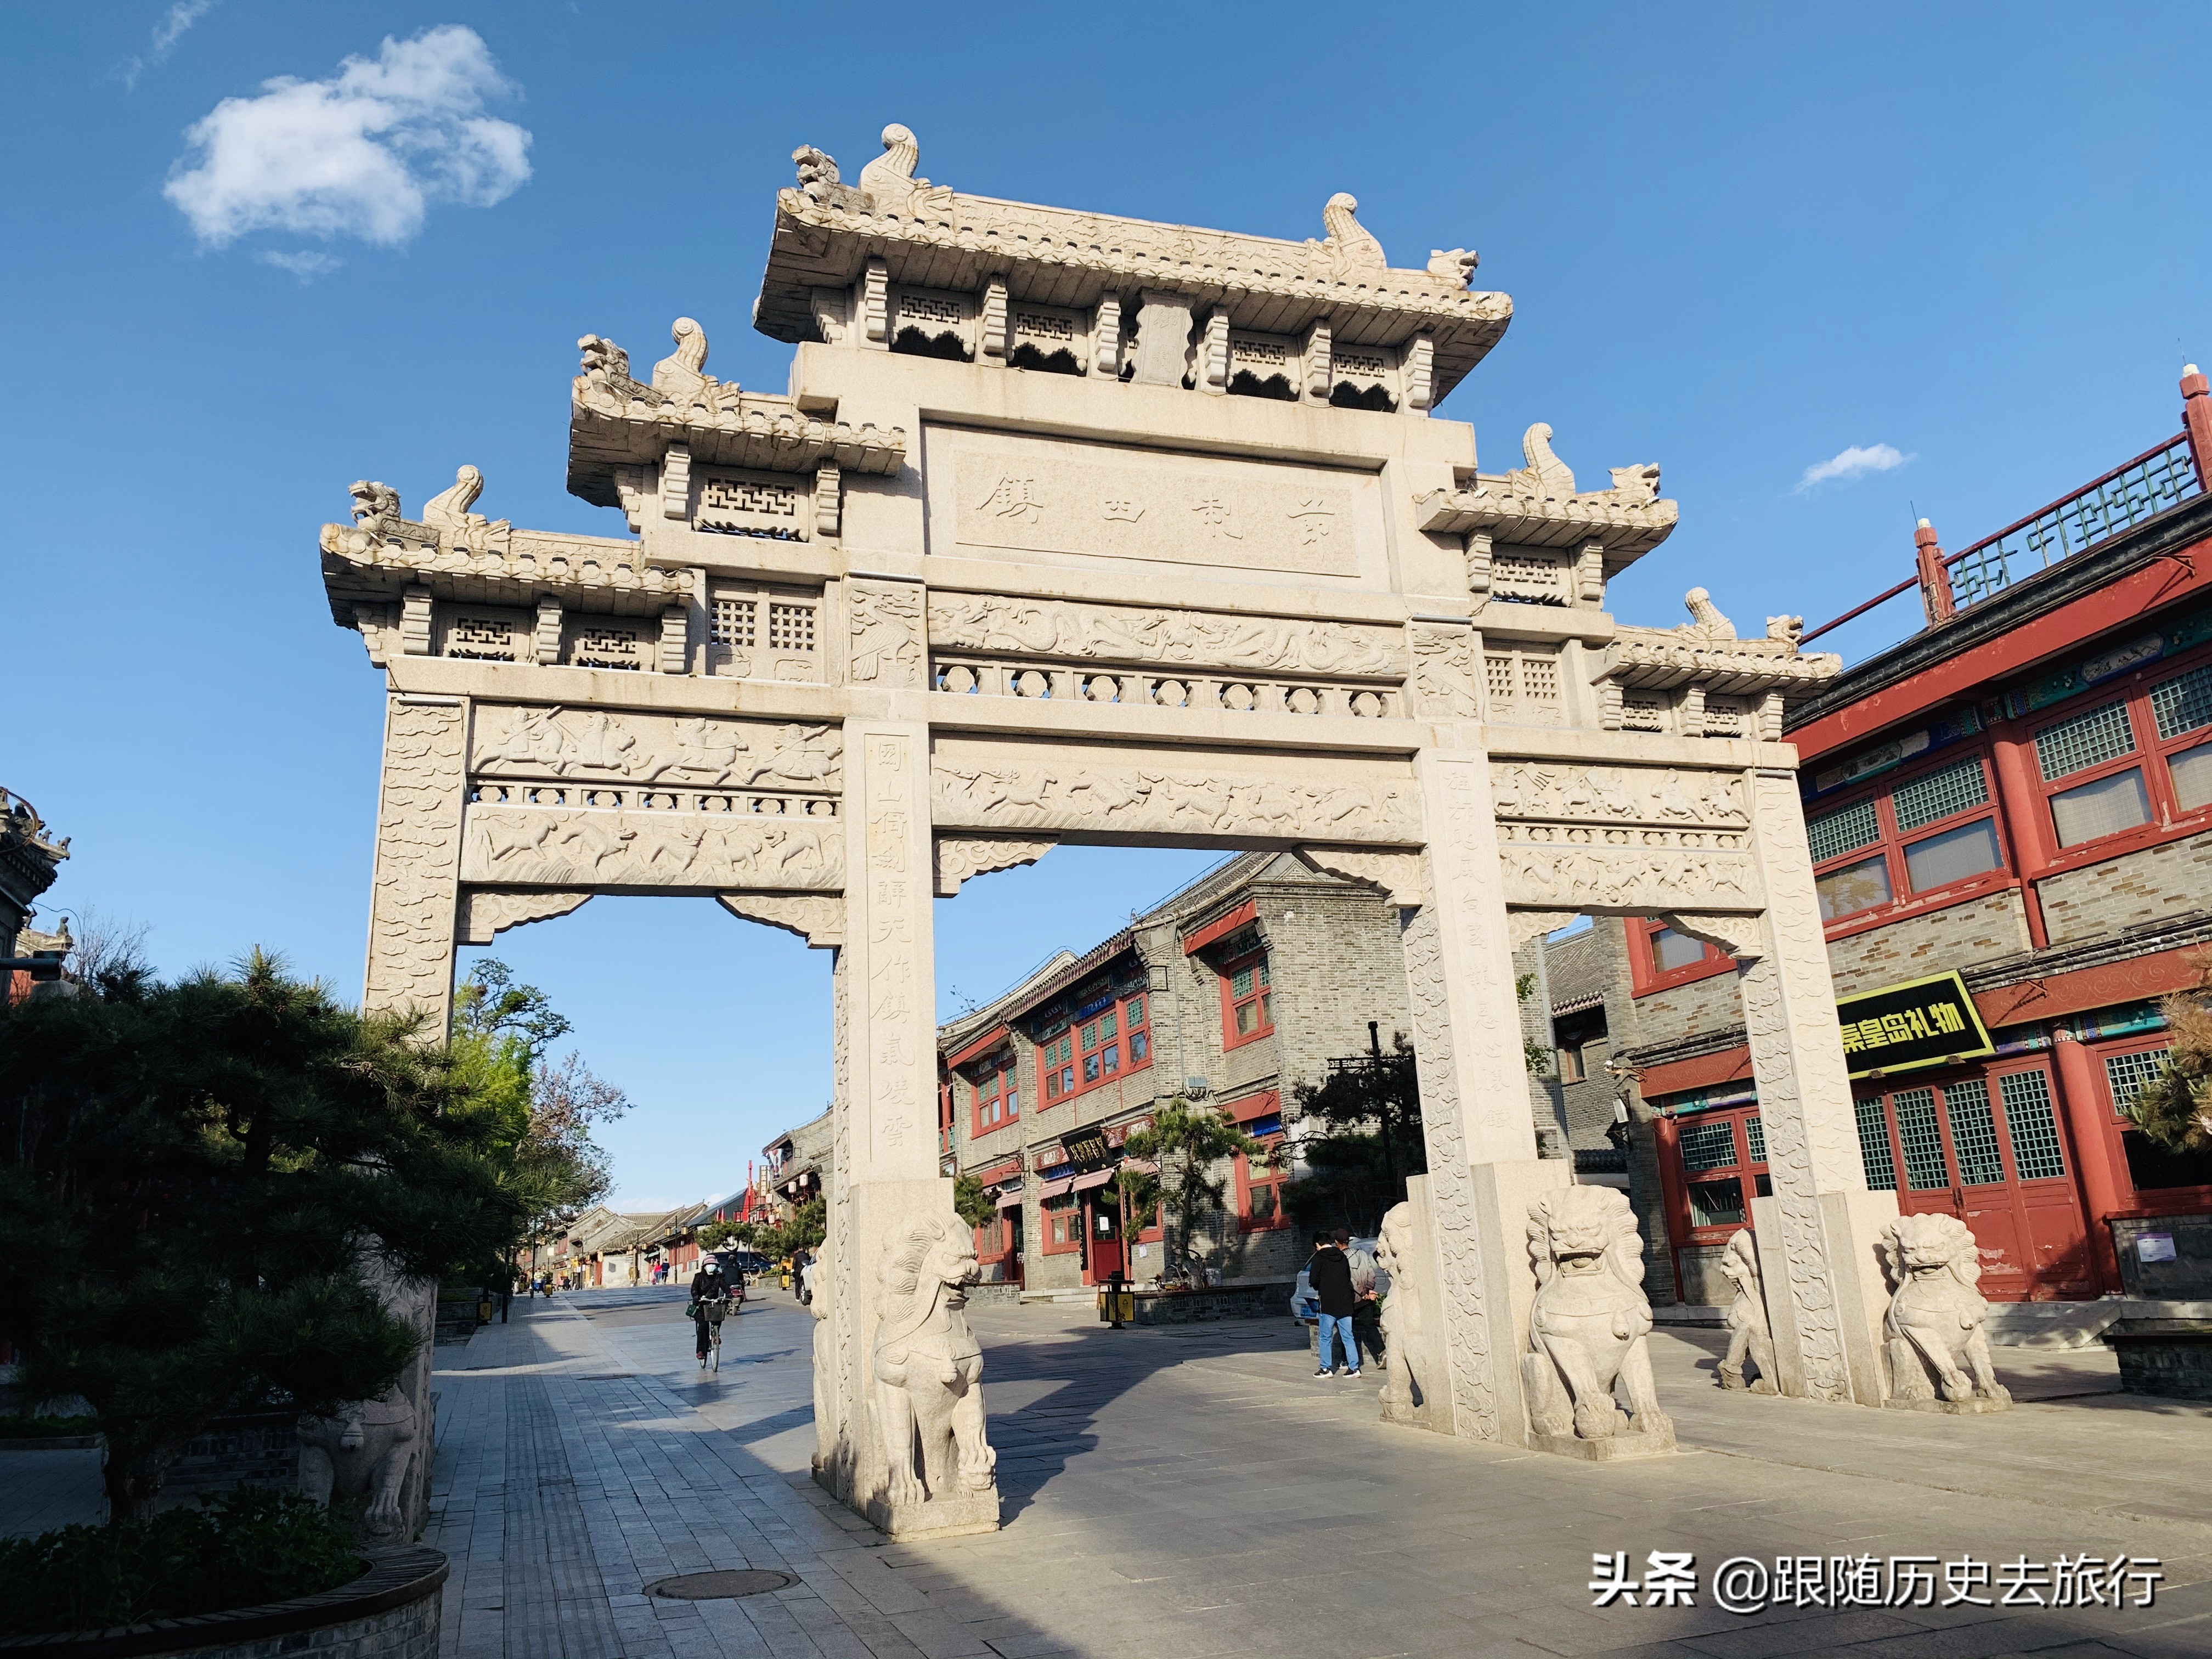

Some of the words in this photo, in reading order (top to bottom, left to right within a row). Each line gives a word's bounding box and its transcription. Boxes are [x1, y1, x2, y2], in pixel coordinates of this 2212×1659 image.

[1839, 1002, 1966, 1053] 秦皇岛礼物
